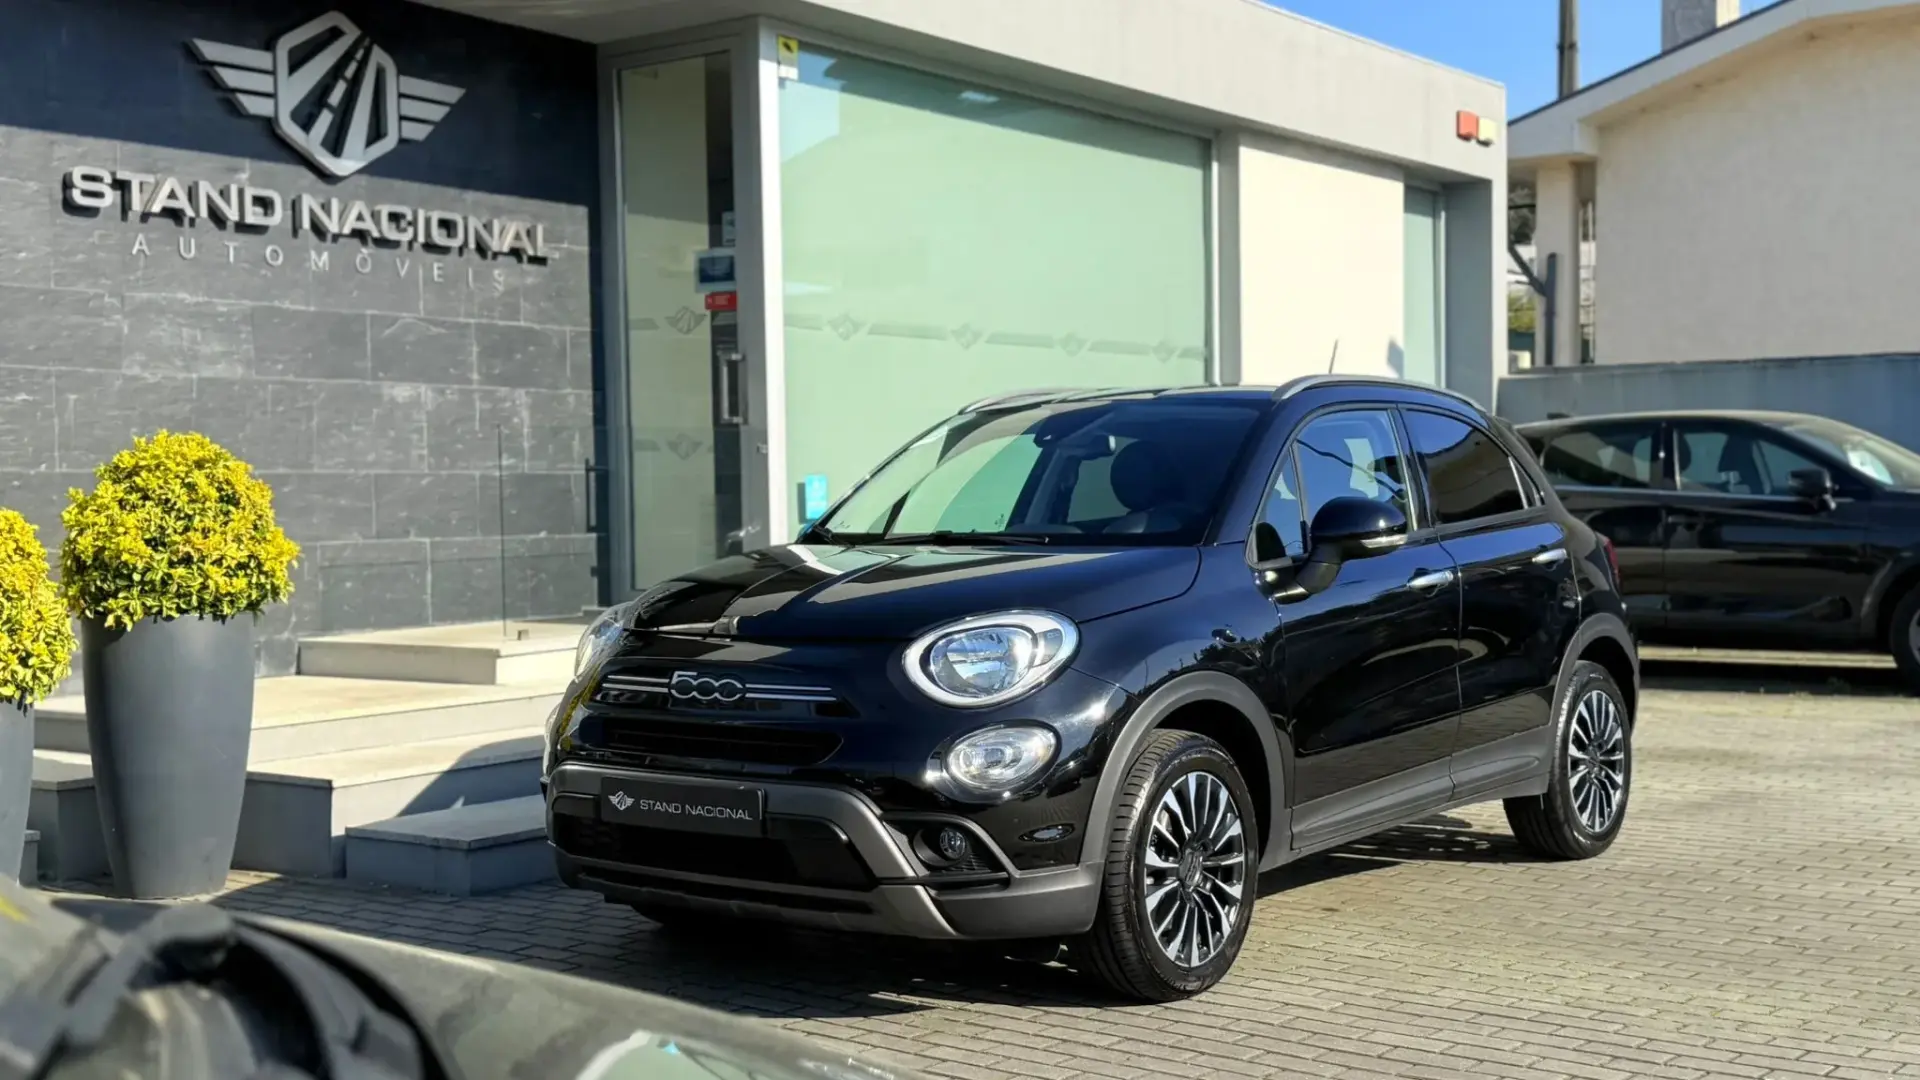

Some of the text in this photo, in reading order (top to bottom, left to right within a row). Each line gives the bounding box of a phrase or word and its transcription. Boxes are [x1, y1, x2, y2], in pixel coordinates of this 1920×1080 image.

[71, 165, 559, 259] STAND NACIONAL
[670, 671, 743, 701] 500
[640, 799, 753, 820] STAND NACIONAL
